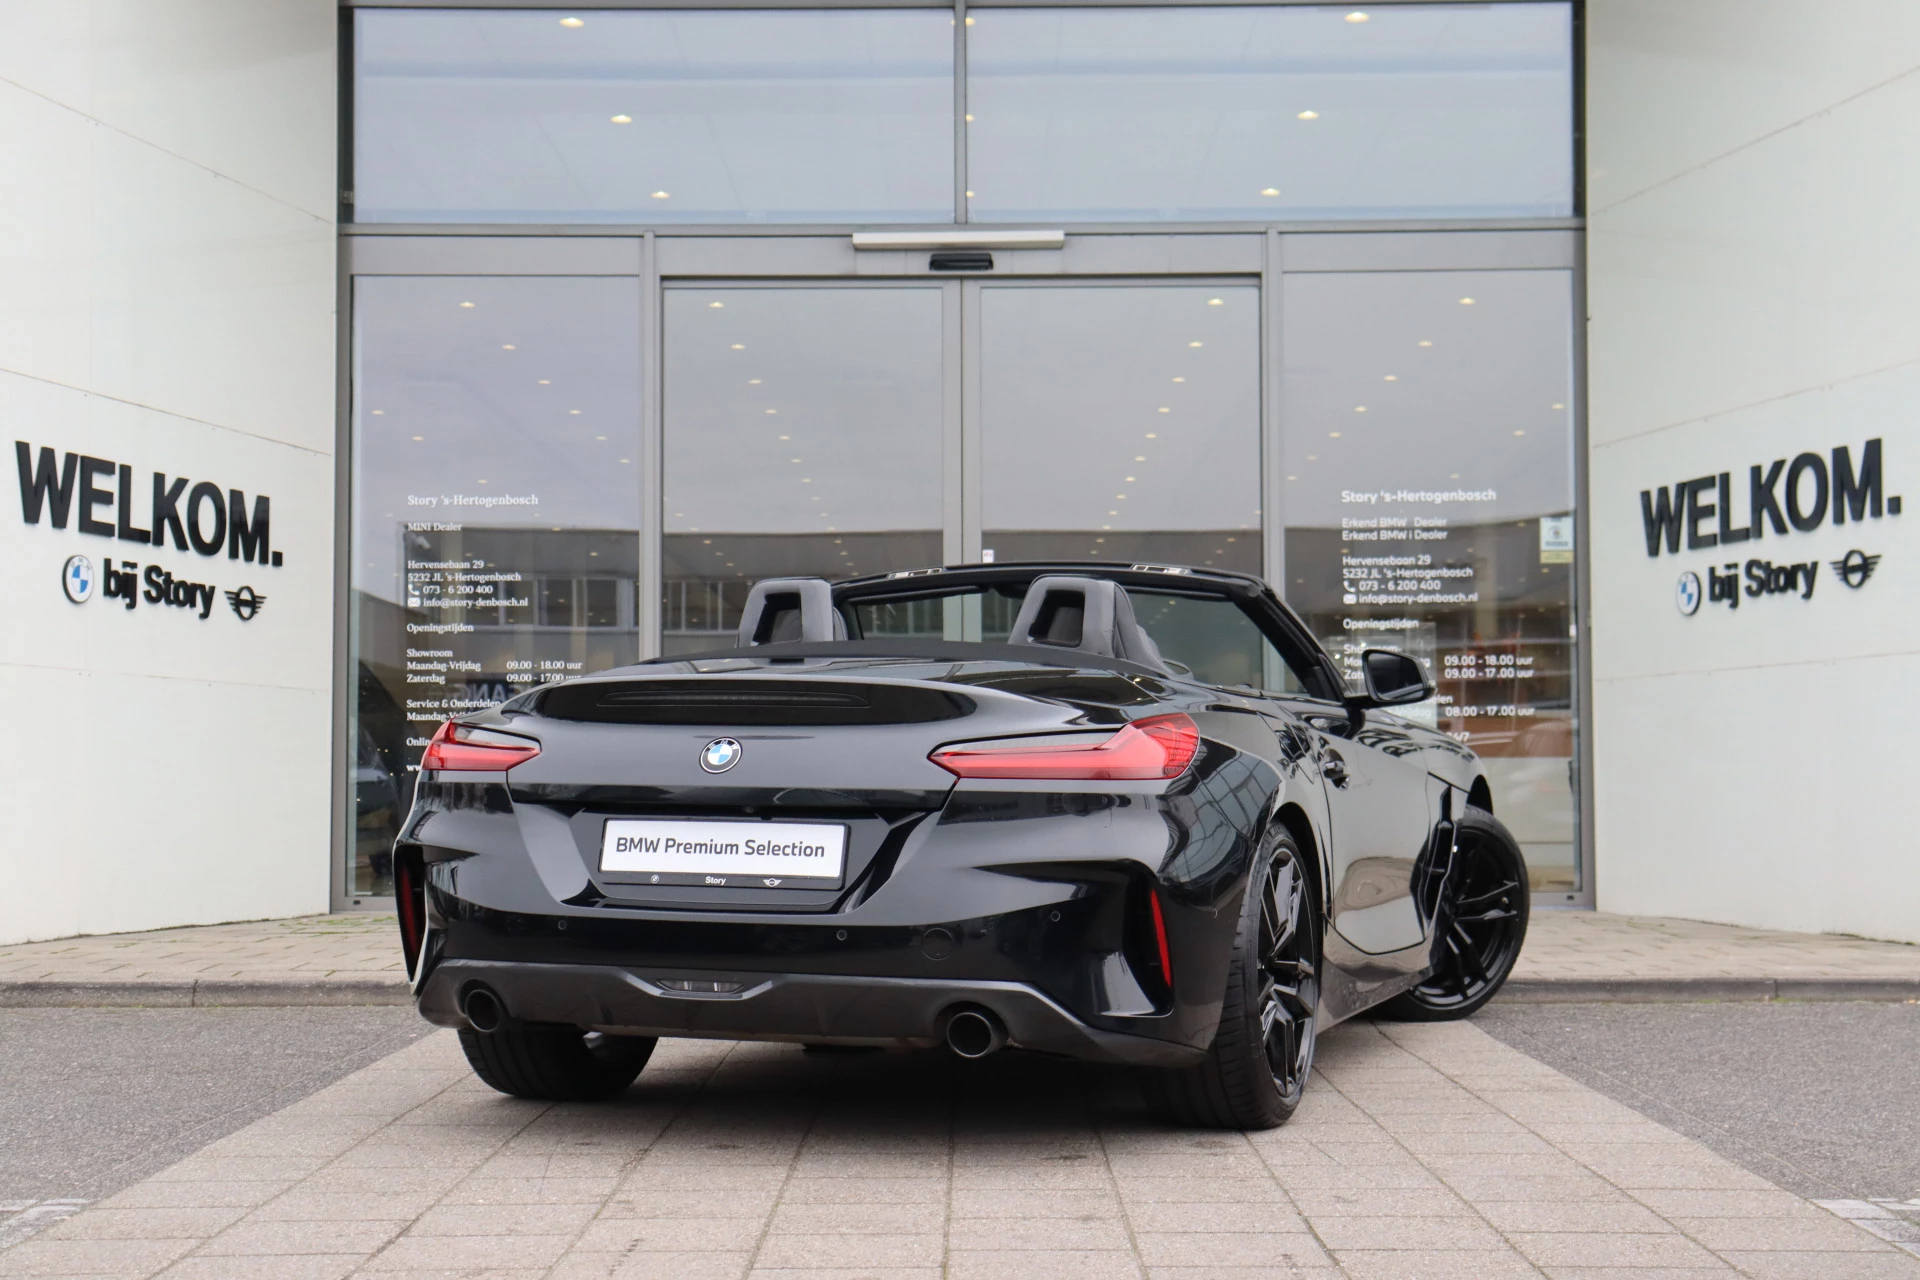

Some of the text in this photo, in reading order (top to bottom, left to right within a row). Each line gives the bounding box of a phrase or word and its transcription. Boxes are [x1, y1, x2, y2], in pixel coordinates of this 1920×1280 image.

[407, 495, 438, 508] Story
[1341, 490, 1378, 504] Story
[1640, 437, 1902, 557] WELKOM.
[15, 440, 283, 567] WELKOM.
[408, 522, 462, 531] MINI Dealer
[1342, 517, 1447, 528] Erkend BMW Dealer
[1342, 531, 1378, 541] Erkend
[1380, 530, 1407, 540] BMW
[1415, 530, 1448, 540] Dealer
[407, 560, 484, 569] Hervensebaan 29
[1342, 555, 1431, 566] Hervensebaan 29
[407, 573, 431, 582] 5232
[432, 573, 443, 582] JL
[1342, 569, 1368, 579] 5232
[1370, 568, 1381, 579] JL
[103, 558, 216, 620] bij Story
[422, 586, 440, 594] 073
[448, 586, 455, 594] 6
[457, 585, 474, 594] 200
[475, 585, 493, 594] 400
[1359, 580, 1378, 591] 073
[1387, 580, 1395, 590] 6
[1397, 580, 1417, 590] 200
[1419, 580, 1441, 590] 400
[1709, 560, 1818, 609] bij Story
[423, 597, 528, 608] info@story-denbosch.nl
[1359, 592, 1478, 606] info@story-denbosch.nl
[406, 623, 474, 634] Openingstijden
[1342, 618, 1419, 630] Openingstijden
[406, 649, 453, 657] Showroom
[1444, 655, 1475, 666] 09.00
[1485, 655, 1514, 665] 18.00
[1516, 656, 1534, 665] uur
[406, 661, 482, 672] Maandag-Vrijdag
[506, 661, 532, 670] 09.00
[540, 661, 565, 669] 18.00
[567, 662, 583, 670] uur
[1444, 668, 1475, 678] 09.00
[1517, 669, 1534, 678] uur
[406, 674, 446, 684] Zaterdag
[506, 674, 532, 682] 09.00
[540, 674, 564, 683] 17.00
[406, 699, 501, 708] Service & Onderdelen
[1445, 706, 1476, 716] 08.00
[1518, 707, 1535, 716] uur
[616, 837, 825, 858] BMW Premium Selection
[705, 876, 727, 886] Story
